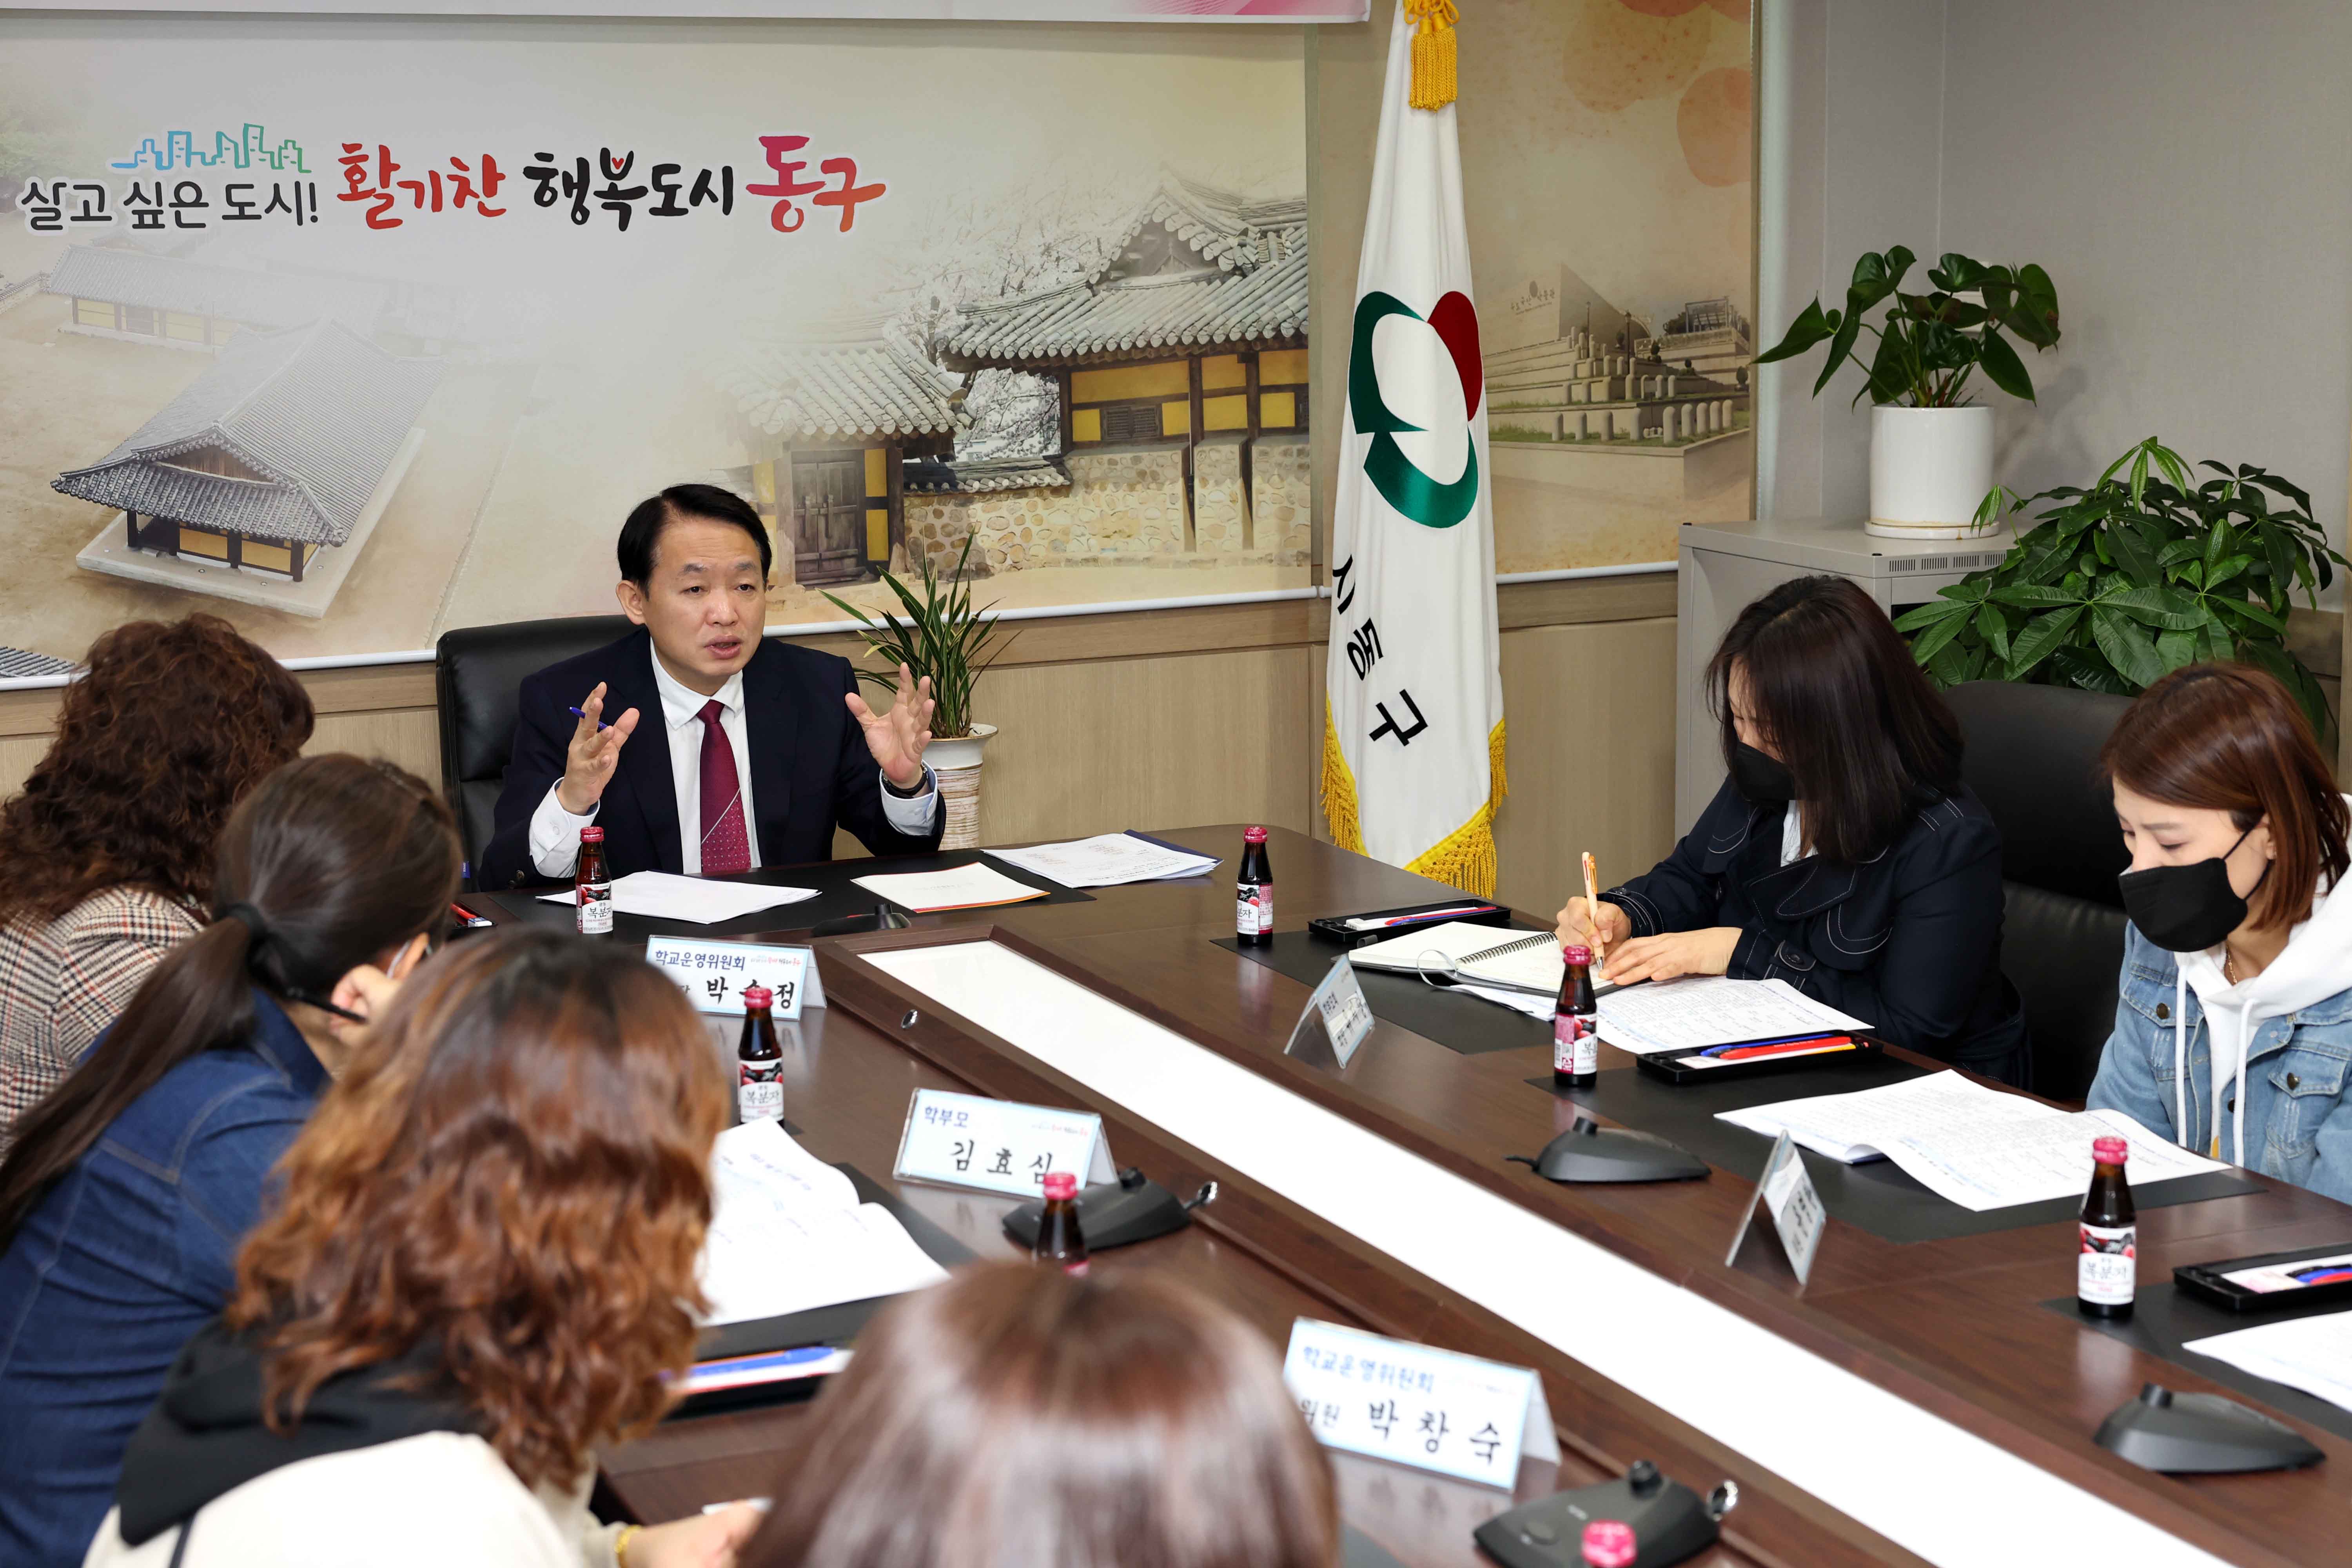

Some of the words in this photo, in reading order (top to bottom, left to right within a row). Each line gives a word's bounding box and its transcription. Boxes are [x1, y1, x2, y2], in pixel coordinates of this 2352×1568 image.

[21, 182, 113, 230] 살고
[123, 181, 209, 229] 싶은
[222, 181, 318, 226] 도시!
[337, 143, 506, 230] 활기찬
[523, 147, 733, 232] 행복도시
[746, 136, 886, 233] 동구
[655, 950, 745, 971] 학교운영위원회
[924, 1105, 969, 1128] 학부모
[1304, 1346, 1435, 1393] 학교운영위원회
